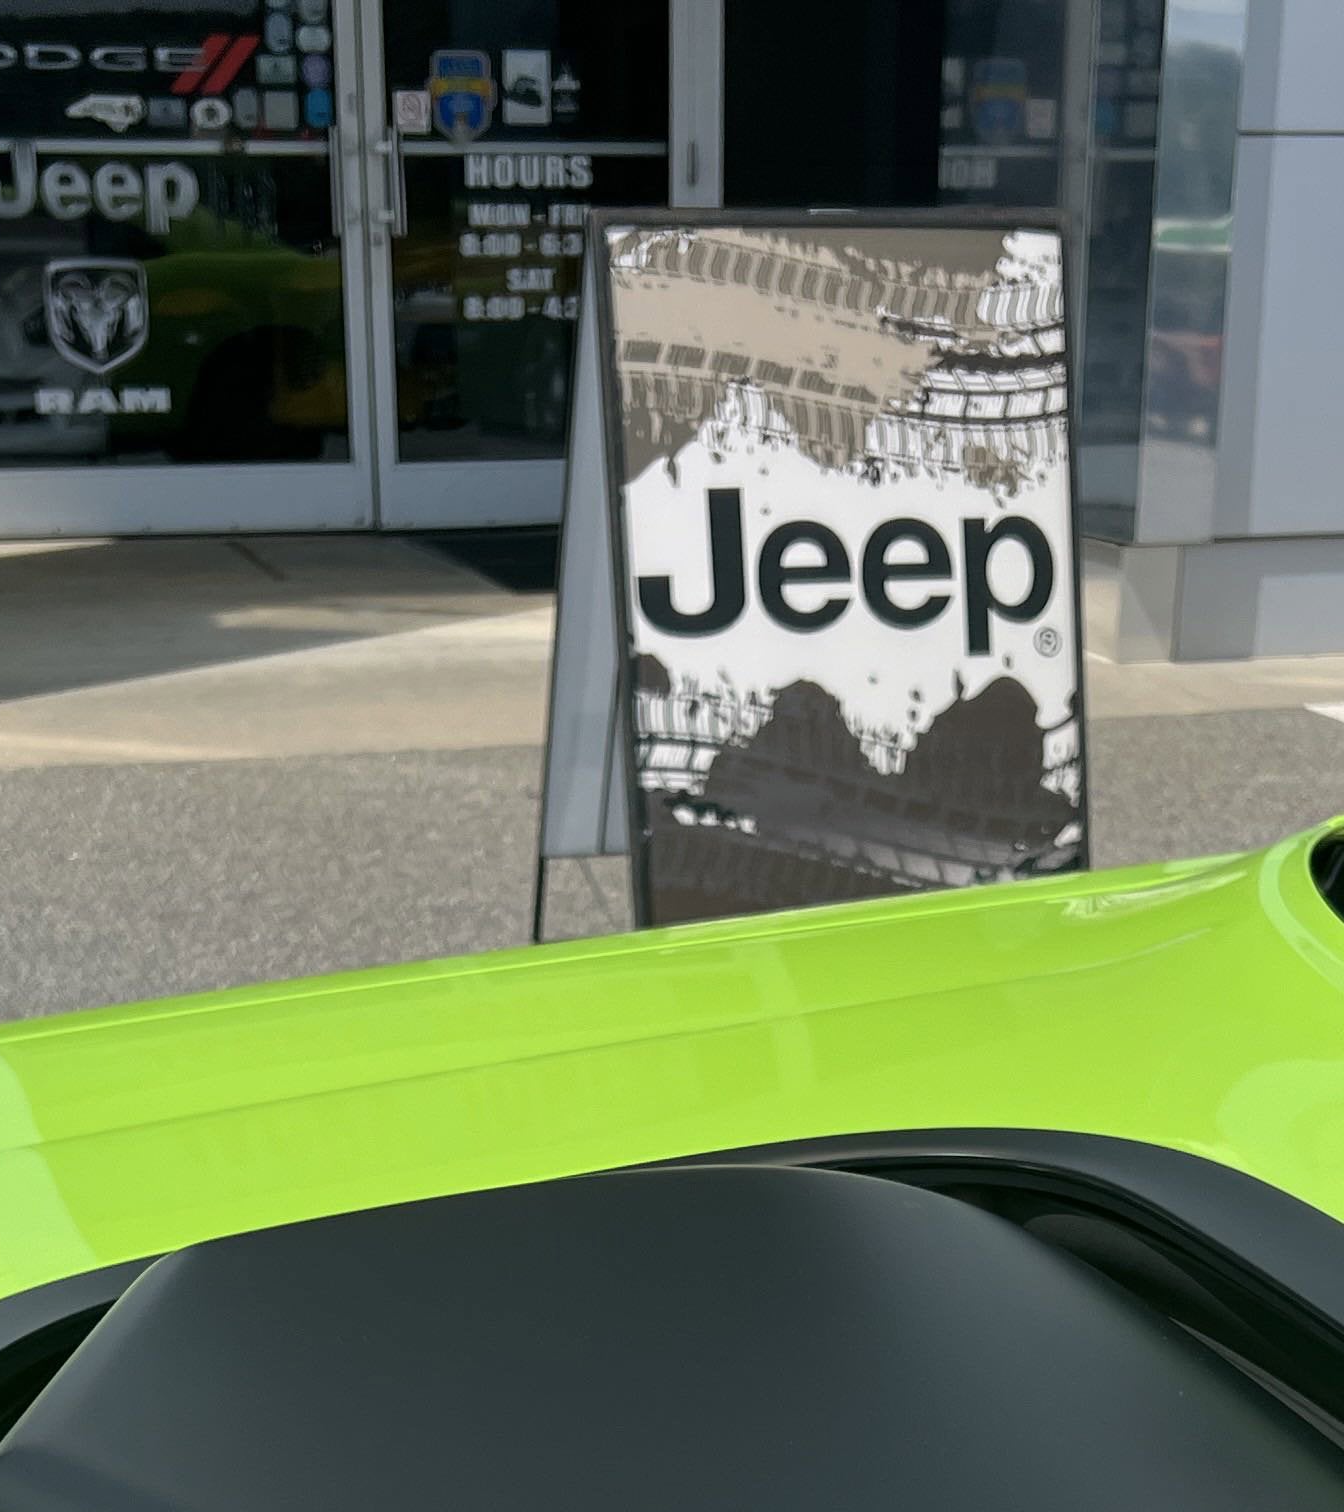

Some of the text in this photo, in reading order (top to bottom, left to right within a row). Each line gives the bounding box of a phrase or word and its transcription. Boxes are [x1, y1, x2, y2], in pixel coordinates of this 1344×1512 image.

[463, 154, 593, 188] HOURS
[467, 203, 531, 226] MON
[505, 268, 555, 291] SAT
[34, 388, 171, 414] RAM
[637, 488, 1056, 657] Jeep
